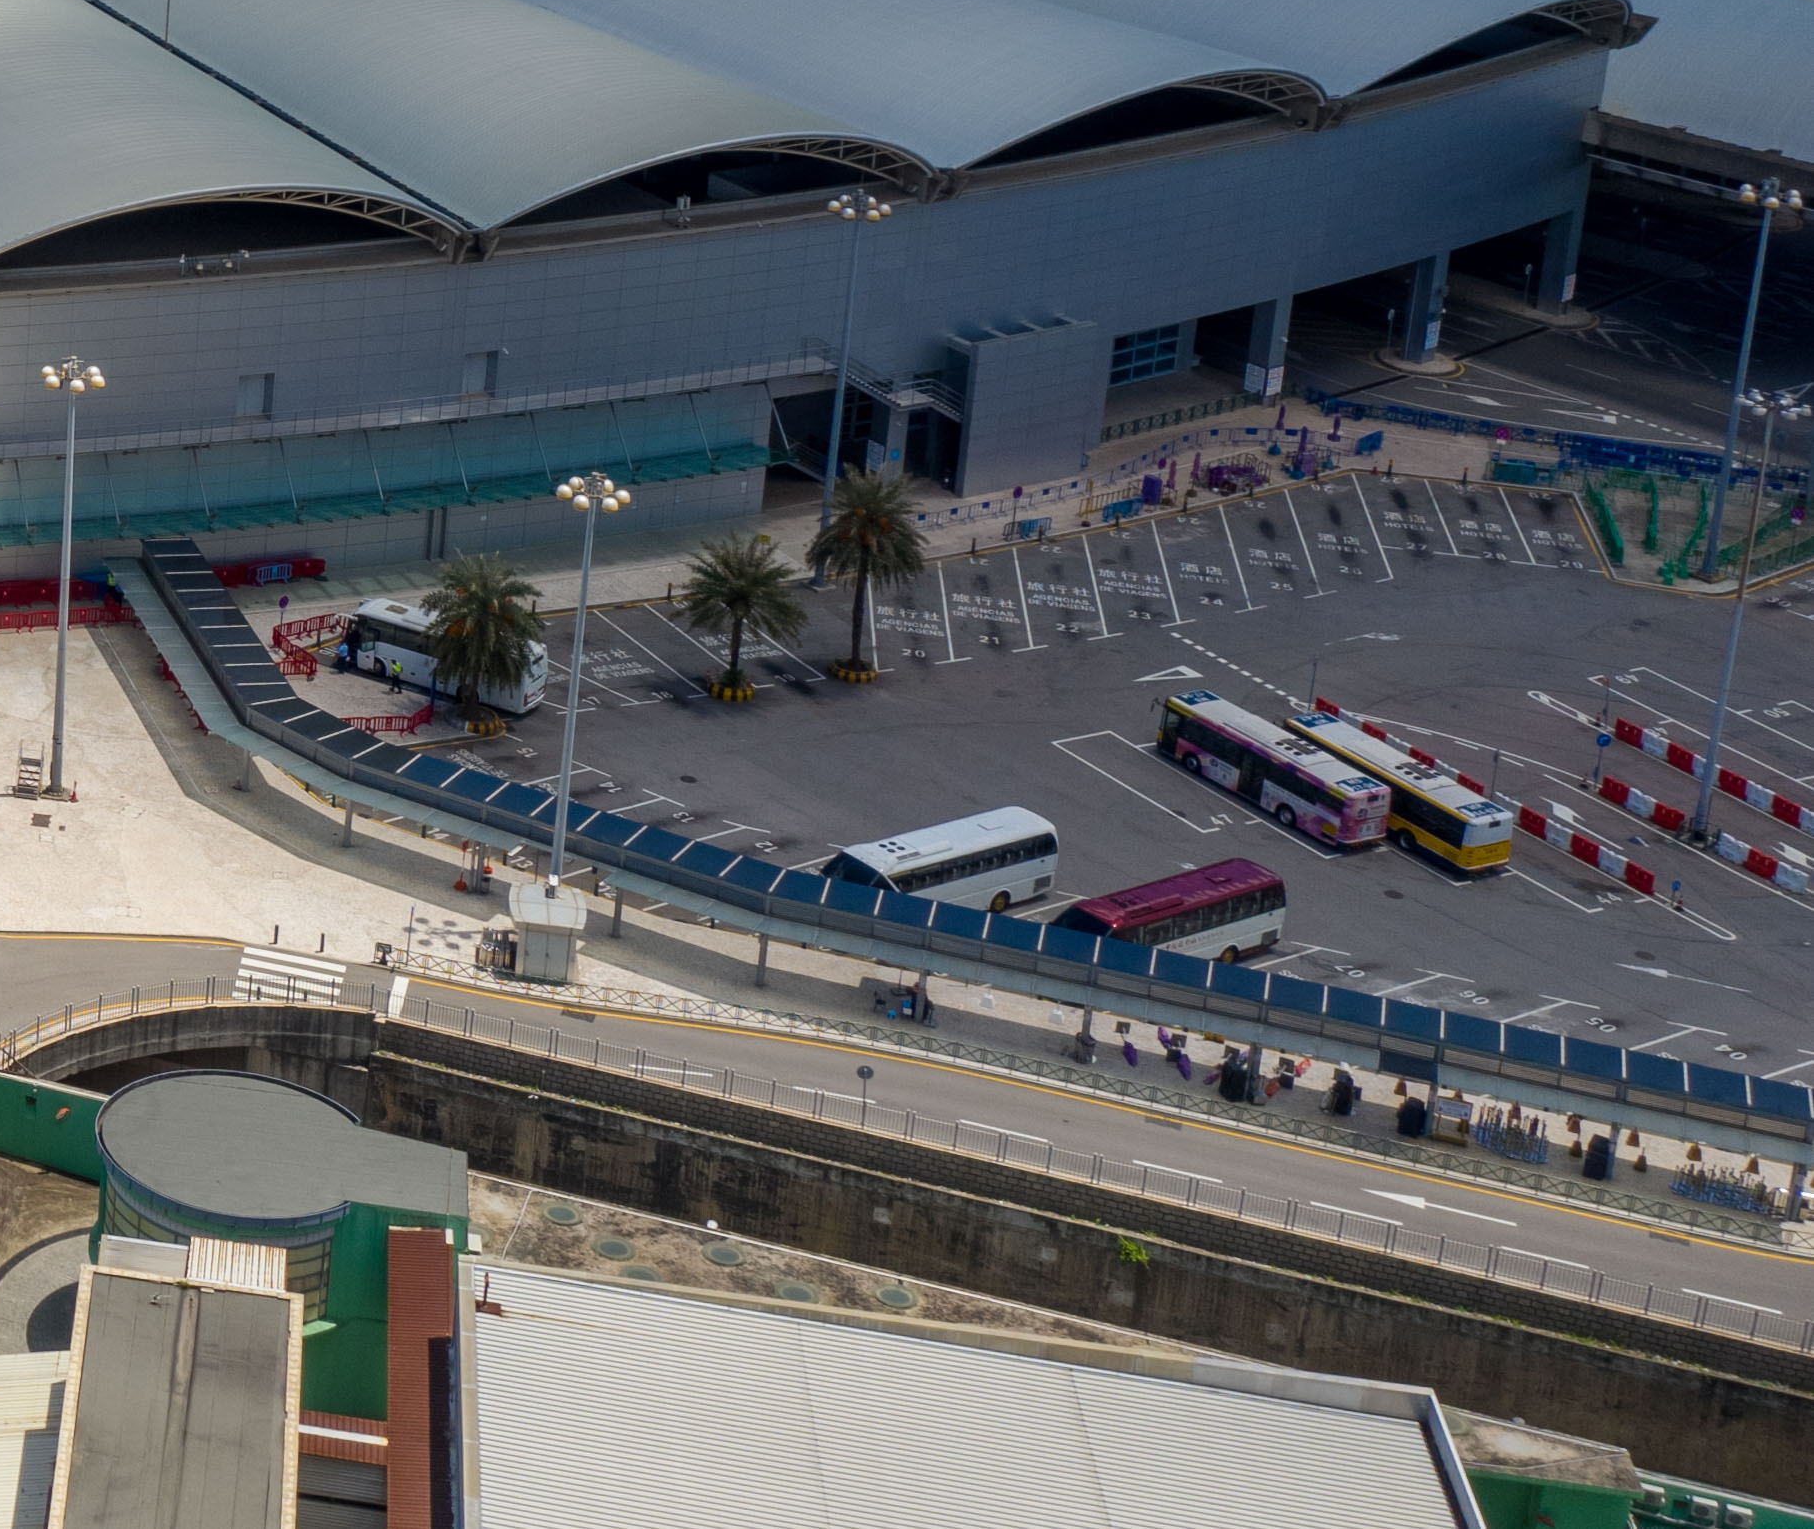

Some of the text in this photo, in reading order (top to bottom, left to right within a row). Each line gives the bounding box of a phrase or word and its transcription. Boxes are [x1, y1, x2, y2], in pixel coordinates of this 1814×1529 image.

[1383, 510, 1426, 524] 酒店
[1459, 519, 1503, 532] 酒店
[1317, 532, 1361, 546] 酒店
[1532, 529, 1576, 543] 酒店
[1406, 542, 1429, 551] 27
[1248, 548, 1292, 563] 酒店
[1483, 551, 1507, 560] 28
[1179, 562, 1223, 576] 酒店
[1339, 566, 1364, 575] 26
[1560, 559, 1584, 569] 29
[1098, 568, 1163, 586] 旅行社
[1026, 581, 1092, 598] 旅行社
[1270, 582, 1294, 591] 25
[1118, 587, 1168, 600] VIAGENS
[952, 593, 1017, 609] 旅行社
[1047, 600, 1096, 613] VIAGENS
[1199, 596, 1224, 606] 24
[876, 605, 942, 622] 旅行社
[973, 613, 1021, 625] VIAGENS
[1127, 609, 1151, 620] 23
[896, 626, 946, 638] VIAGENS
[1055, 622, 1080, 633] 22
[979, 634, 1000, 645] 21
[901, 648, 926, 659] 20
[592, 667, 656, 680] DE VIAGENS
[651, 690, 674, 701] 18
[1211, 813, 1234, 825] 47
[1334, 963, 1366, 979] 07
[1459, 989, 1491, 1006] 06
[1585, 1015, 1618, 1034] 05
[1712, 1042, 1748, 1061] 04
